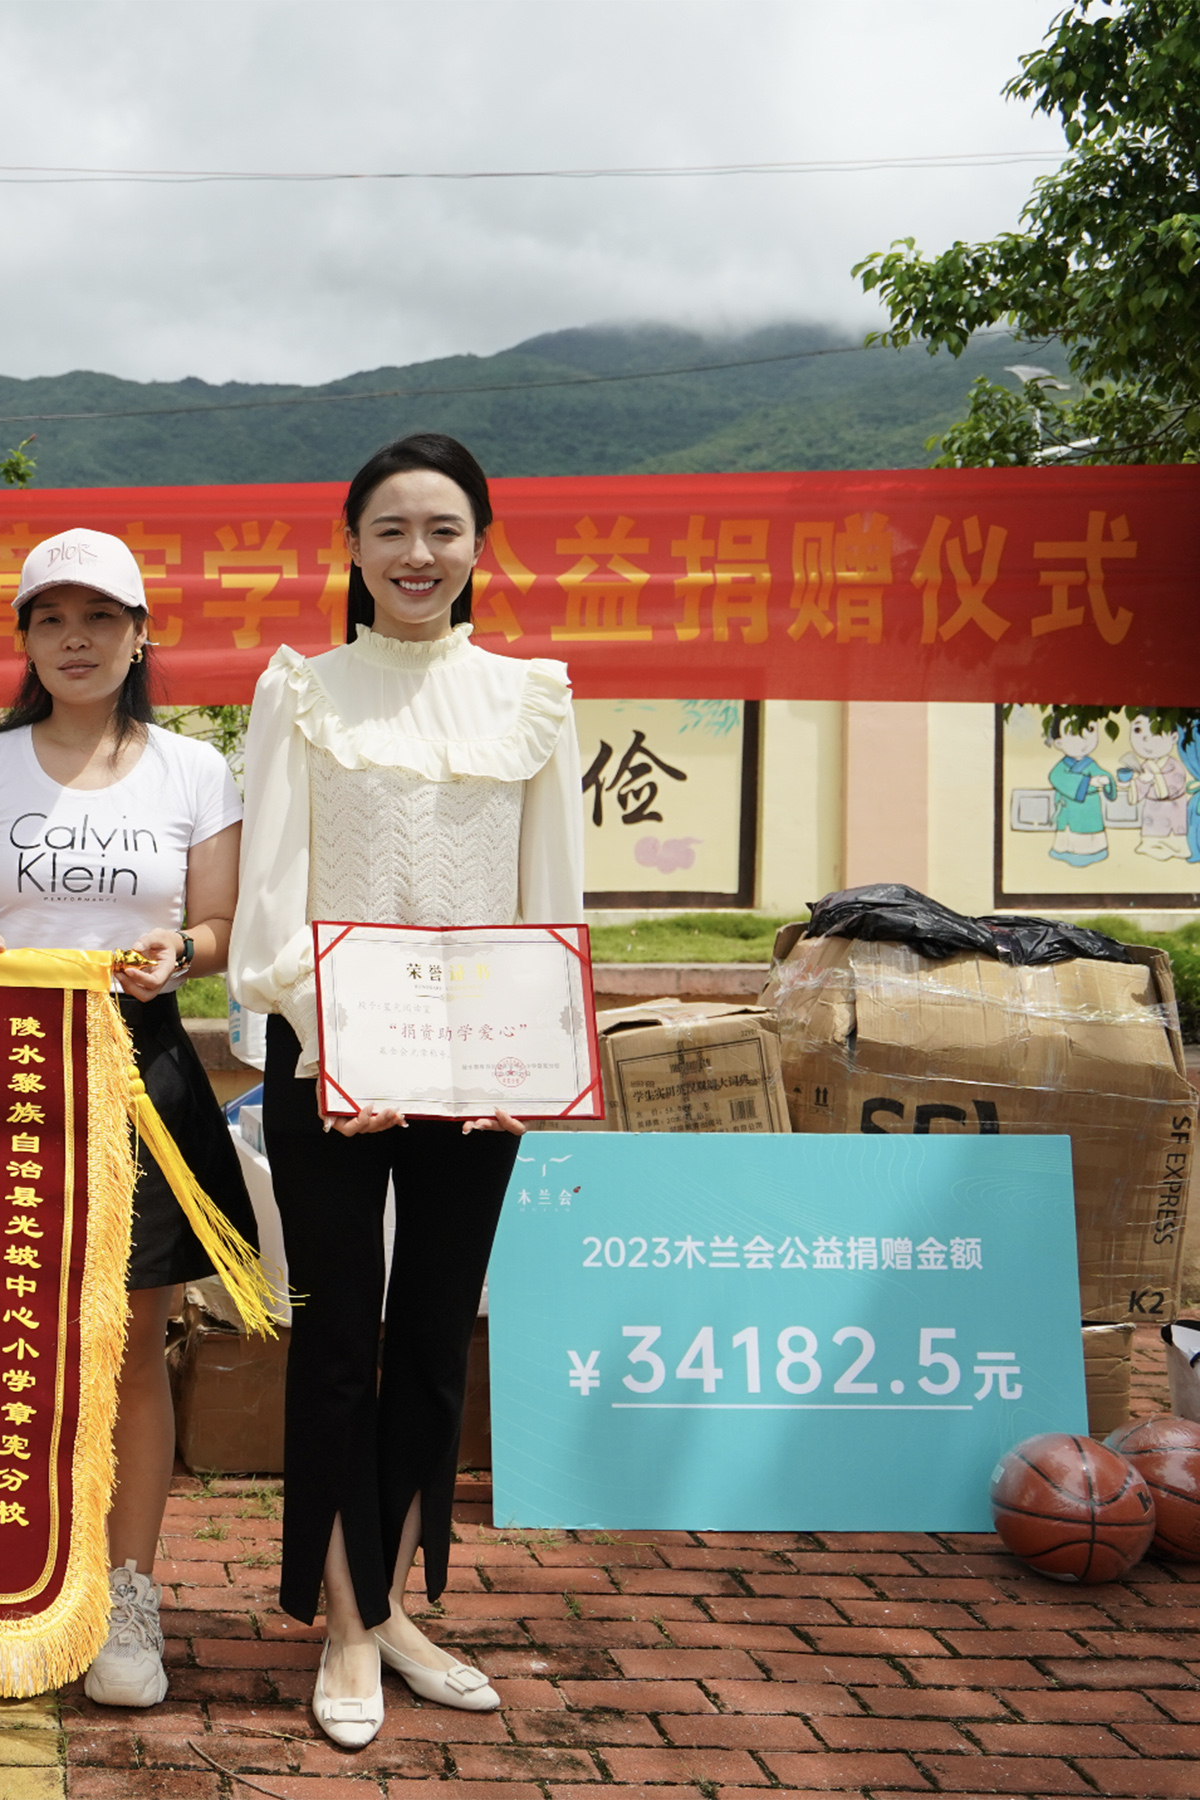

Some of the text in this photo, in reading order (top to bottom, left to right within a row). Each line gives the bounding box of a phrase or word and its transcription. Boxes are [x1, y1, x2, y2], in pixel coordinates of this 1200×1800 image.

[582, 730, 687, 827] 俭
[10, 812, 158, 854] Calvin
[17, 851, 138, 896] Klein
[406, 962, 490, 982] 荣誉证书
[517, 1189, 573, 1206] 木兰会
[1153, 1116, 1192, 1245] SF EXPRESS
[583, 1236, 983, 1271] 2023木兰会公益捐赠金额
[1128, 1290, 1164, 1314] K2
